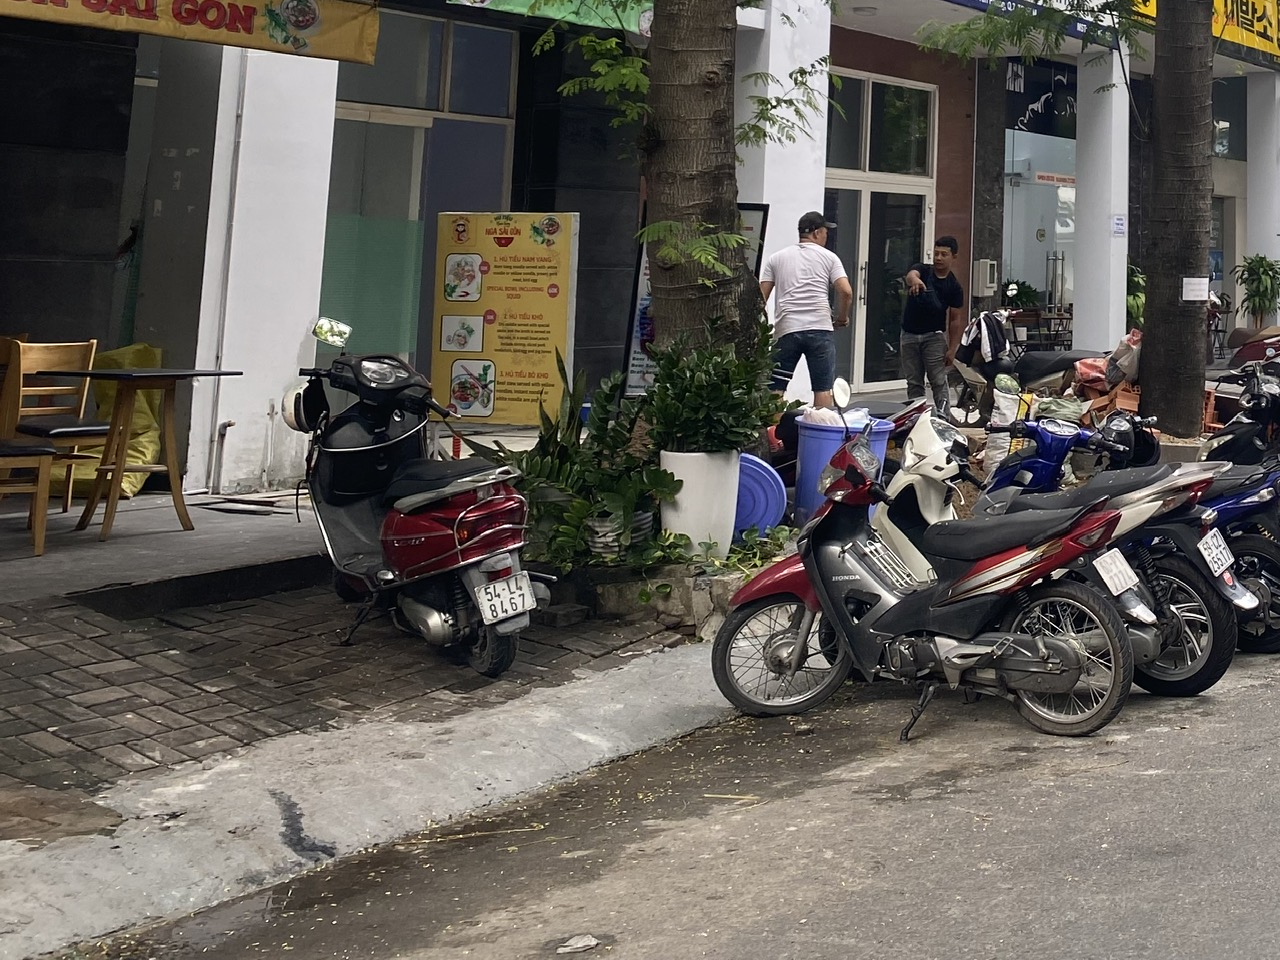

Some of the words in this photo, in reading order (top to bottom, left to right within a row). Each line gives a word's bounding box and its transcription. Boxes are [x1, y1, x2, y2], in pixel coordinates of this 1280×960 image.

[484, 577, 524, 602] 54-L4
[832, 574, 861, 582] HONDA
[489, 593, 526, 619] 8467
